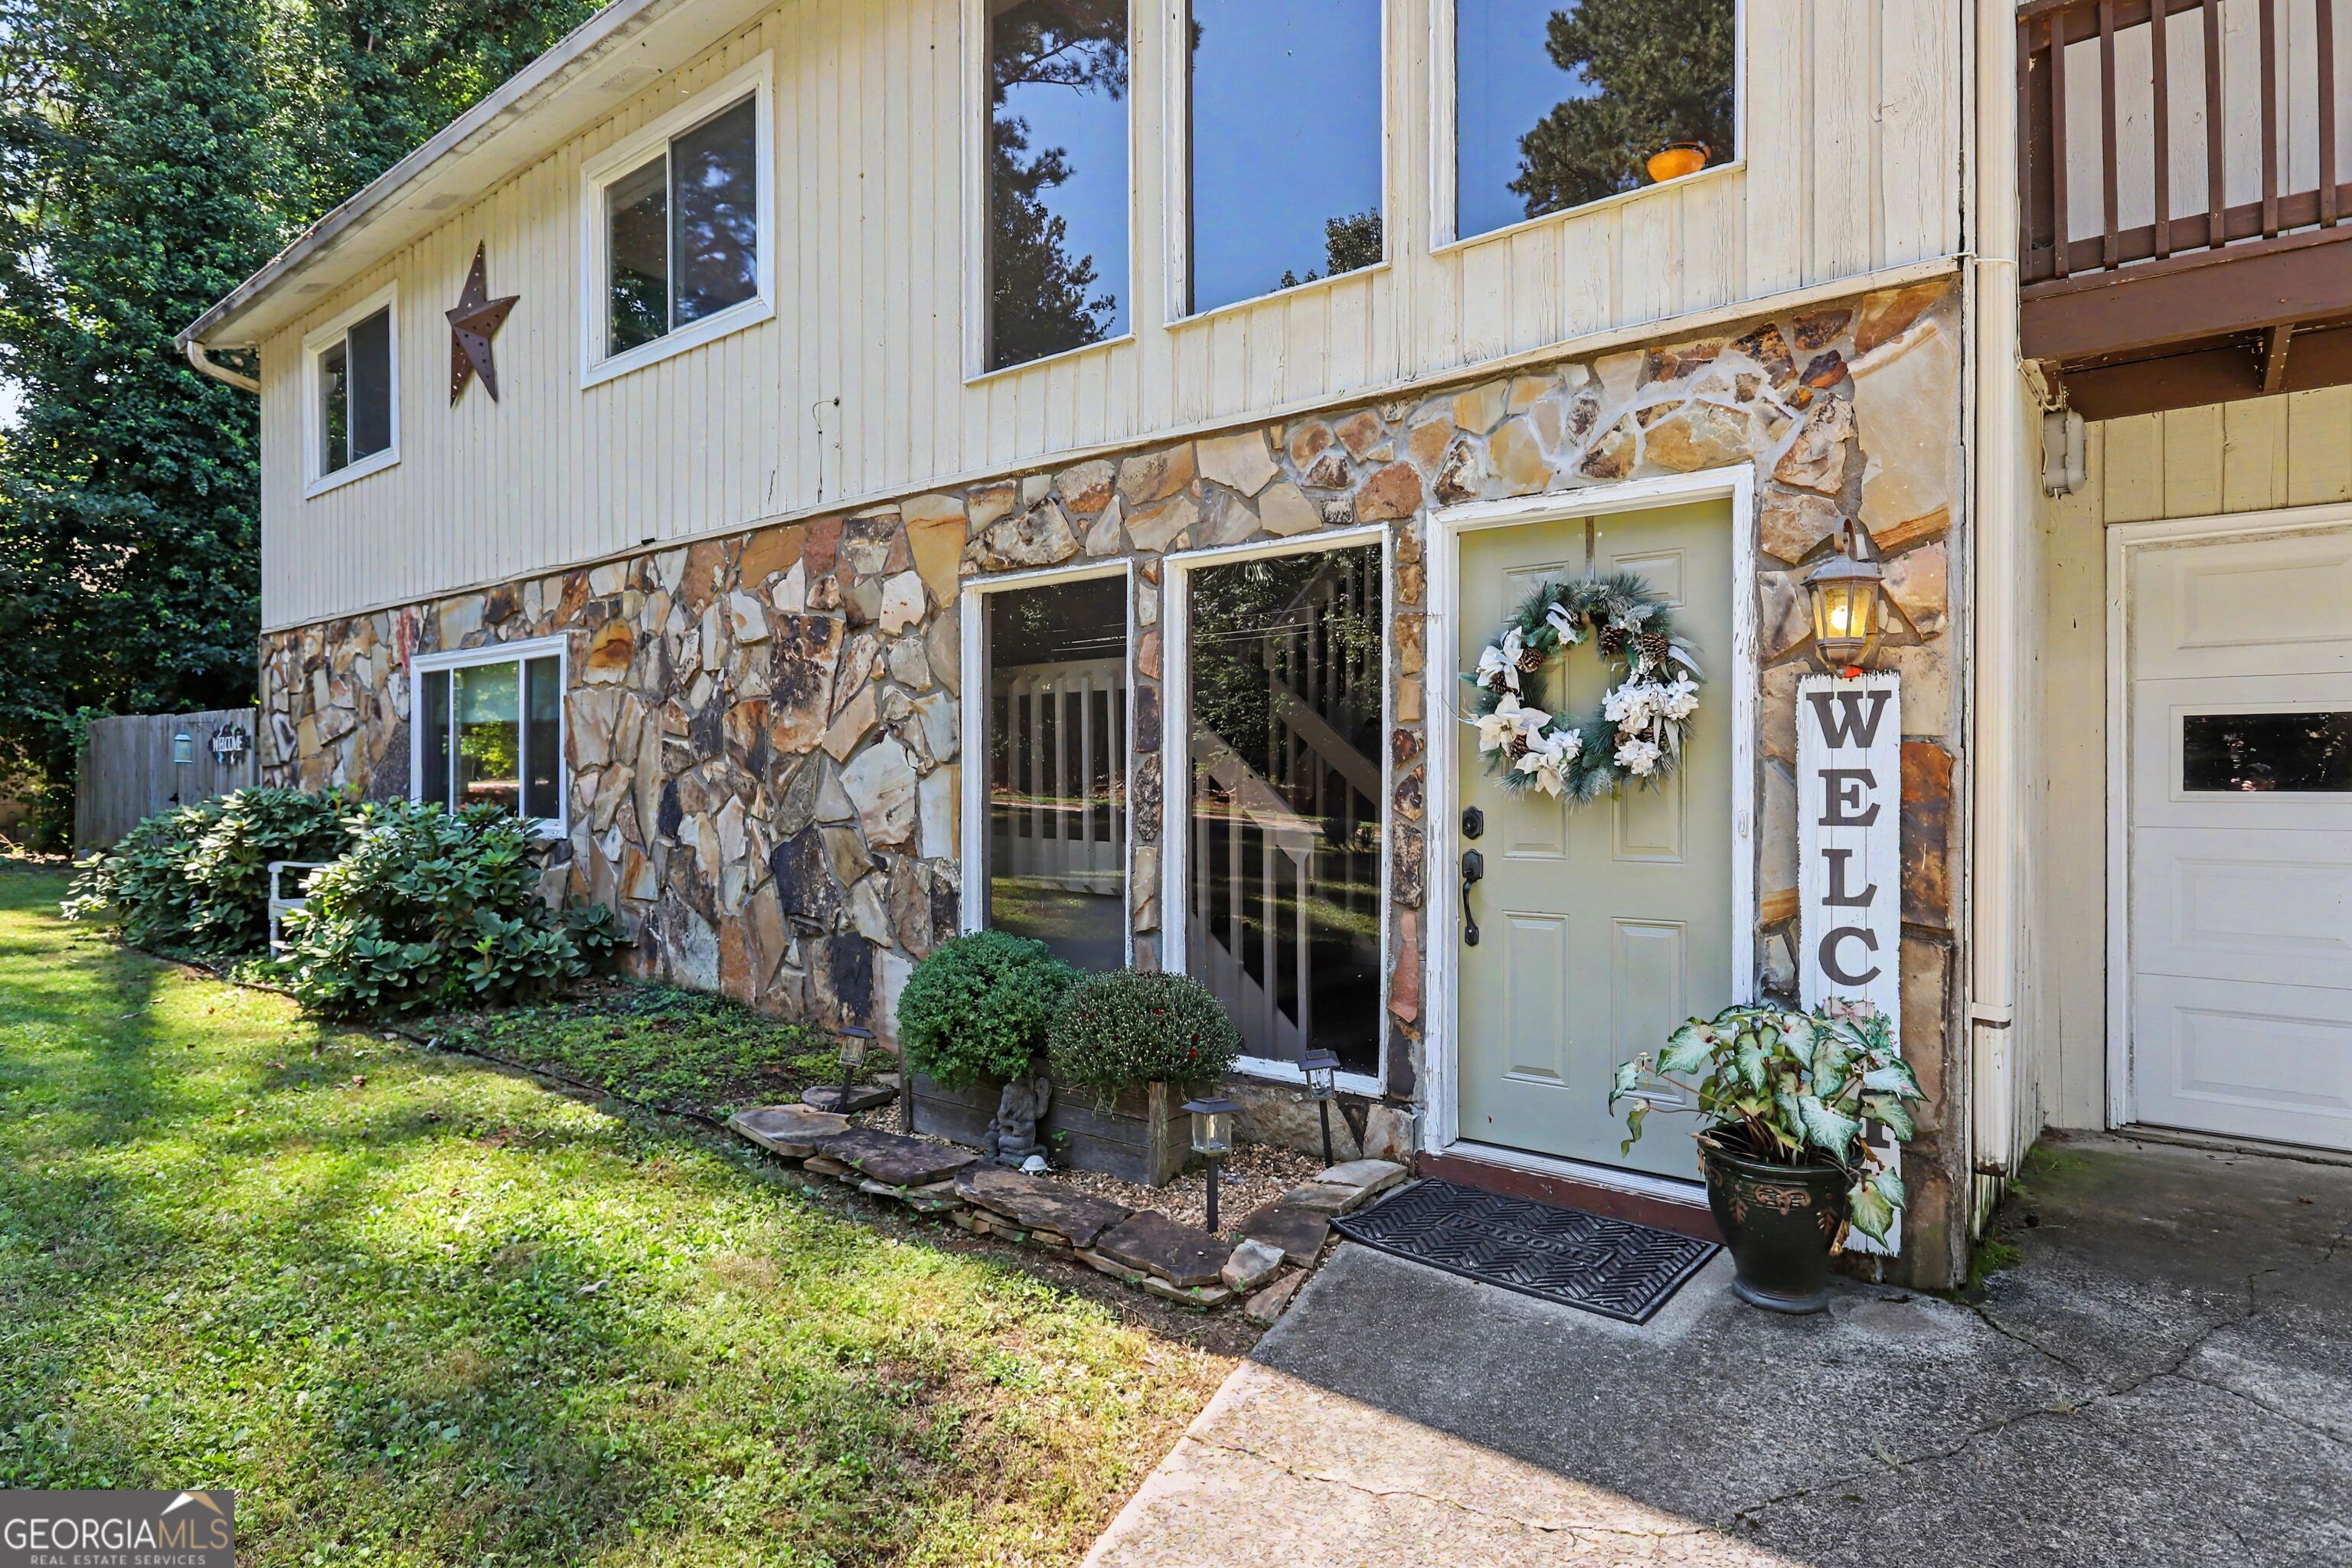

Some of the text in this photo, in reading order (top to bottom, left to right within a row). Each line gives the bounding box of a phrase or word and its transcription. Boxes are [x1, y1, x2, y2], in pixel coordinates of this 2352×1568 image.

[212, 735, 243, 752] WELCOME
[1805, 690, 1891, 1176] WELC
[1449, 1216, 1602, 1261] WELCOME
